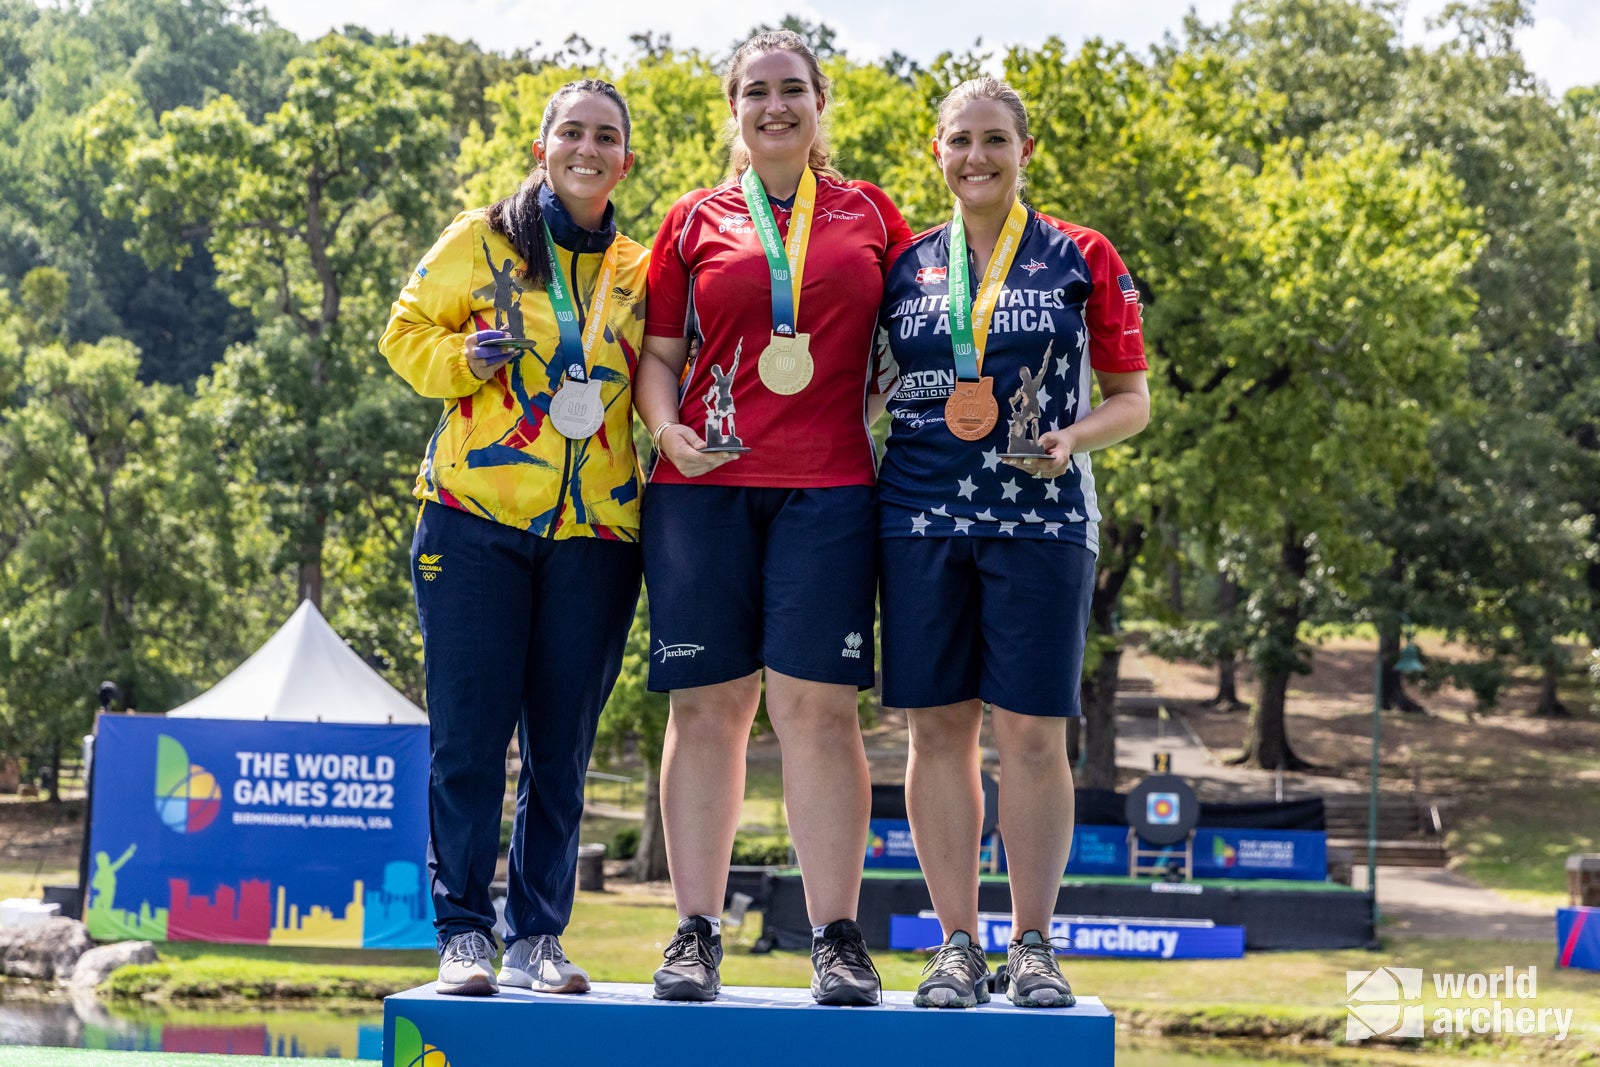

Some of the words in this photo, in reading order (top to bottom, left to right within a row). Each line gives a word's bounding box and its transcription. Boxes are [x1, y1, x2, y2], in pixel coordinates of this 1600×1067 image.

[750, 184, 760, 199] World
[755, 199, 765, 216] Games
[760, 215, 769, 228] 2022
[764, 227, 780, 259] Birmingham
[789, 242, 800, 257] 2022
[996, 234, 1013, 266] Birmingham
[991, 266, 1000, 280] 2022
[984, 279, 996, 299] Games
[584, 333, 594, 352] World
[589, 313, 599, 332] Games
[594, 299, 602, 313] 2022
[598, 267, 611, 300] Birmingham
[891, 294, 950, 319] UNITE
[998, 288, 1065, 310] TATES
[956, 295, 964, 329] Birmingham
[977, 298, 989, 317] World
[900, 314, 928, 340] OF
[933, 309, 1056, 335] ARICA
[973, 316, 982, 329] The
[666, 647, 697, 658] archery
[235, 751, 291, 779] THE
[294, 753, 396, 782] WORLD
[232, 778, 329, 808] GAMES
[330, 781, 395, 810] 2022
[232, 811, 308, 830] BIRMINGHAM,
[308, 814, 367, 831] ALABAMA,
[367, 816, 393, 830] USA
[1074, 925, 1179, 958] archery
